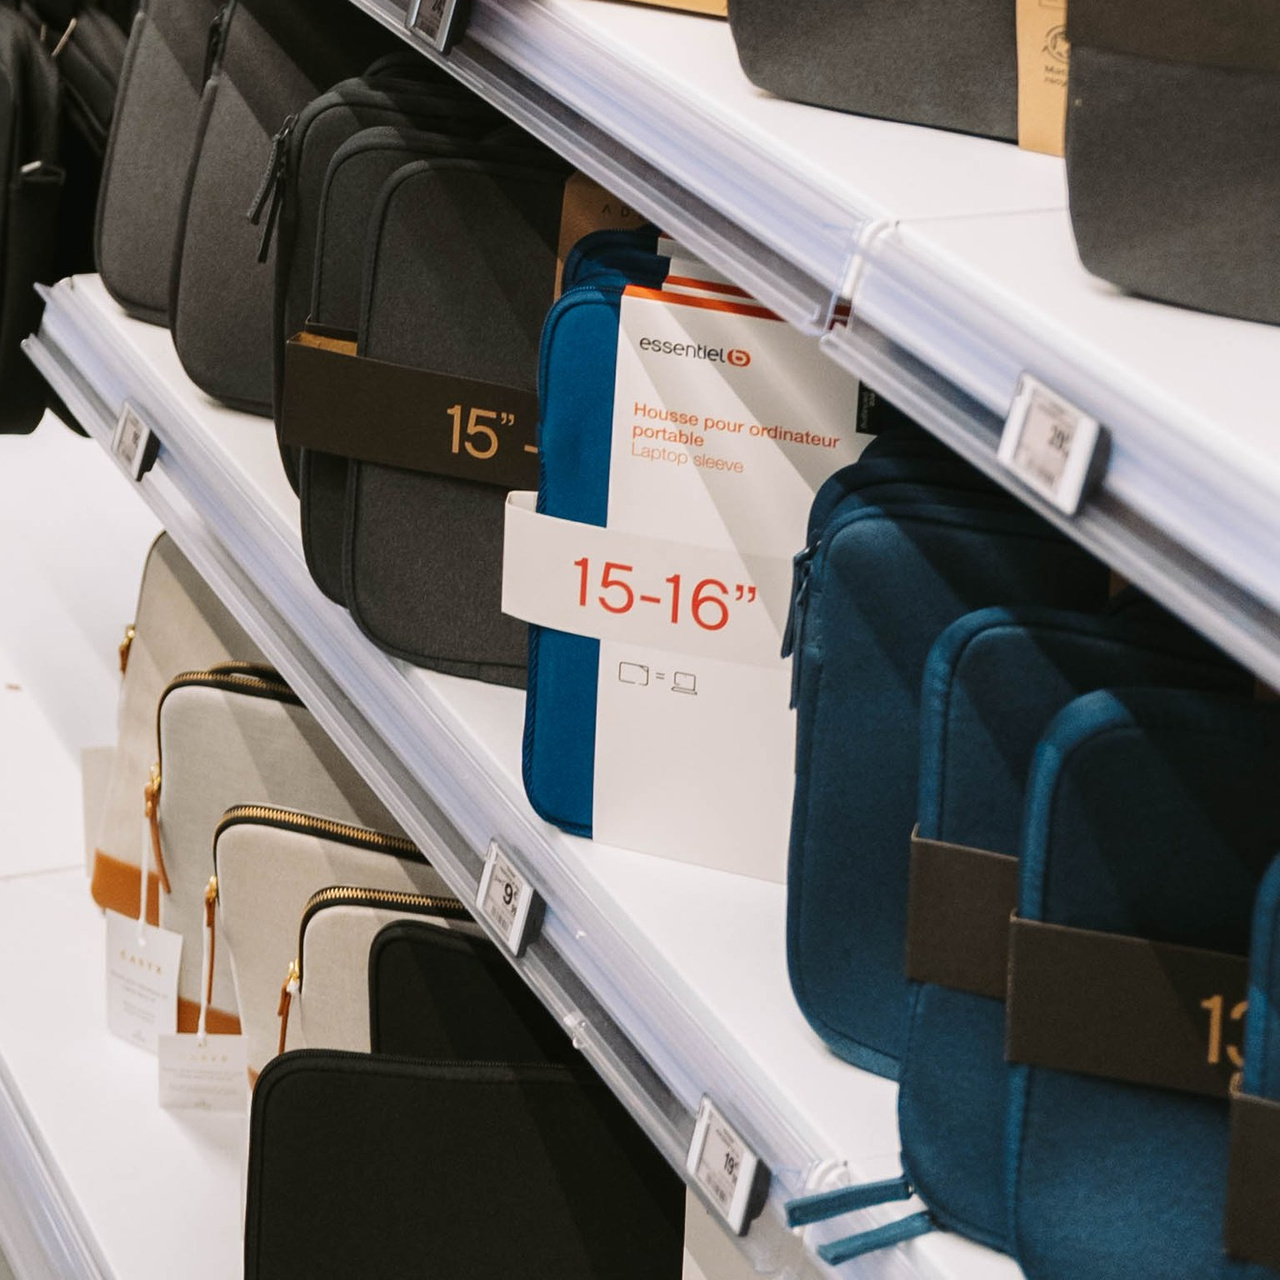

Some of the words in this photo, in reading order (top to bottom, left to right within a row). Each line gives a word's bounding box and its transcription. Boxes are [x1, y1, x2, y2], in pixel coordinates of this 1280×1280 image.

[639, 337, 726, 363] essentiel
[447, 404, 515, 460] 15”
[632, 425, 704, 448] portable
[634, 402, 699, 427] Housse
[704, 416, 745, 434] pour
[749, 423, 840, 449] ordinateur
[631, 441, 688, 466] Laptop
[693, 452, 745, 474] sleeve
[574, 556, 757, 631] 15-16”
